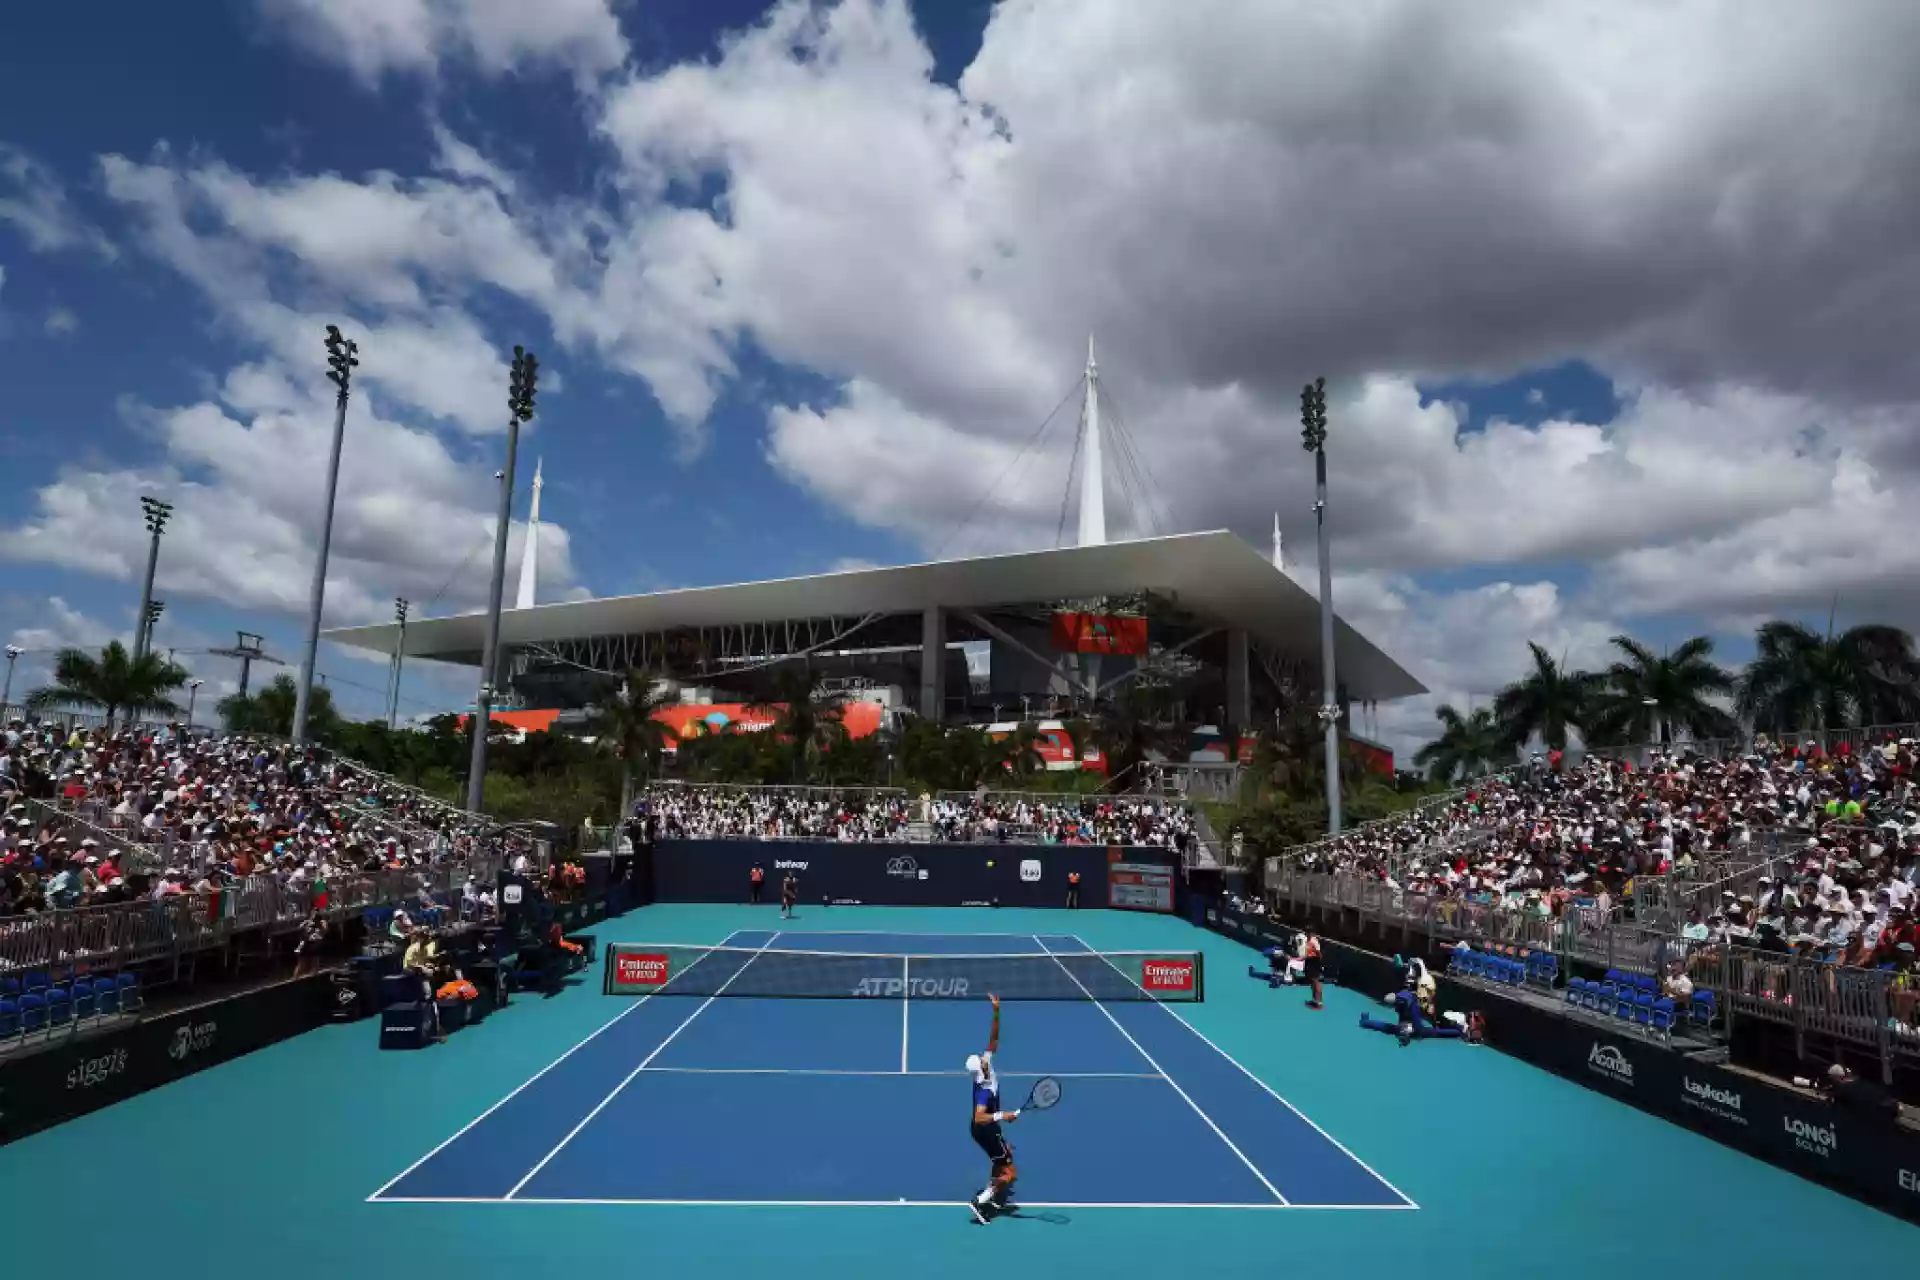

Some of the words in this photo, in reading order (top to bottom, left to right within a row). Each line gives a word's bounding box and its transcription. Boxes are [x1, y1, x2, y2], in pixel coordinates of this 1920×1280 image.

[775, 859, 808, 870] betway
[619, 959, 665, 970] Emirates
[1146, 965, 1192, 976] Emirates
[850, 977, 903, 996] ATP
[908, 978, 969, 996] TOUR
[1684, 1075, 1741, 1110] Laykold
